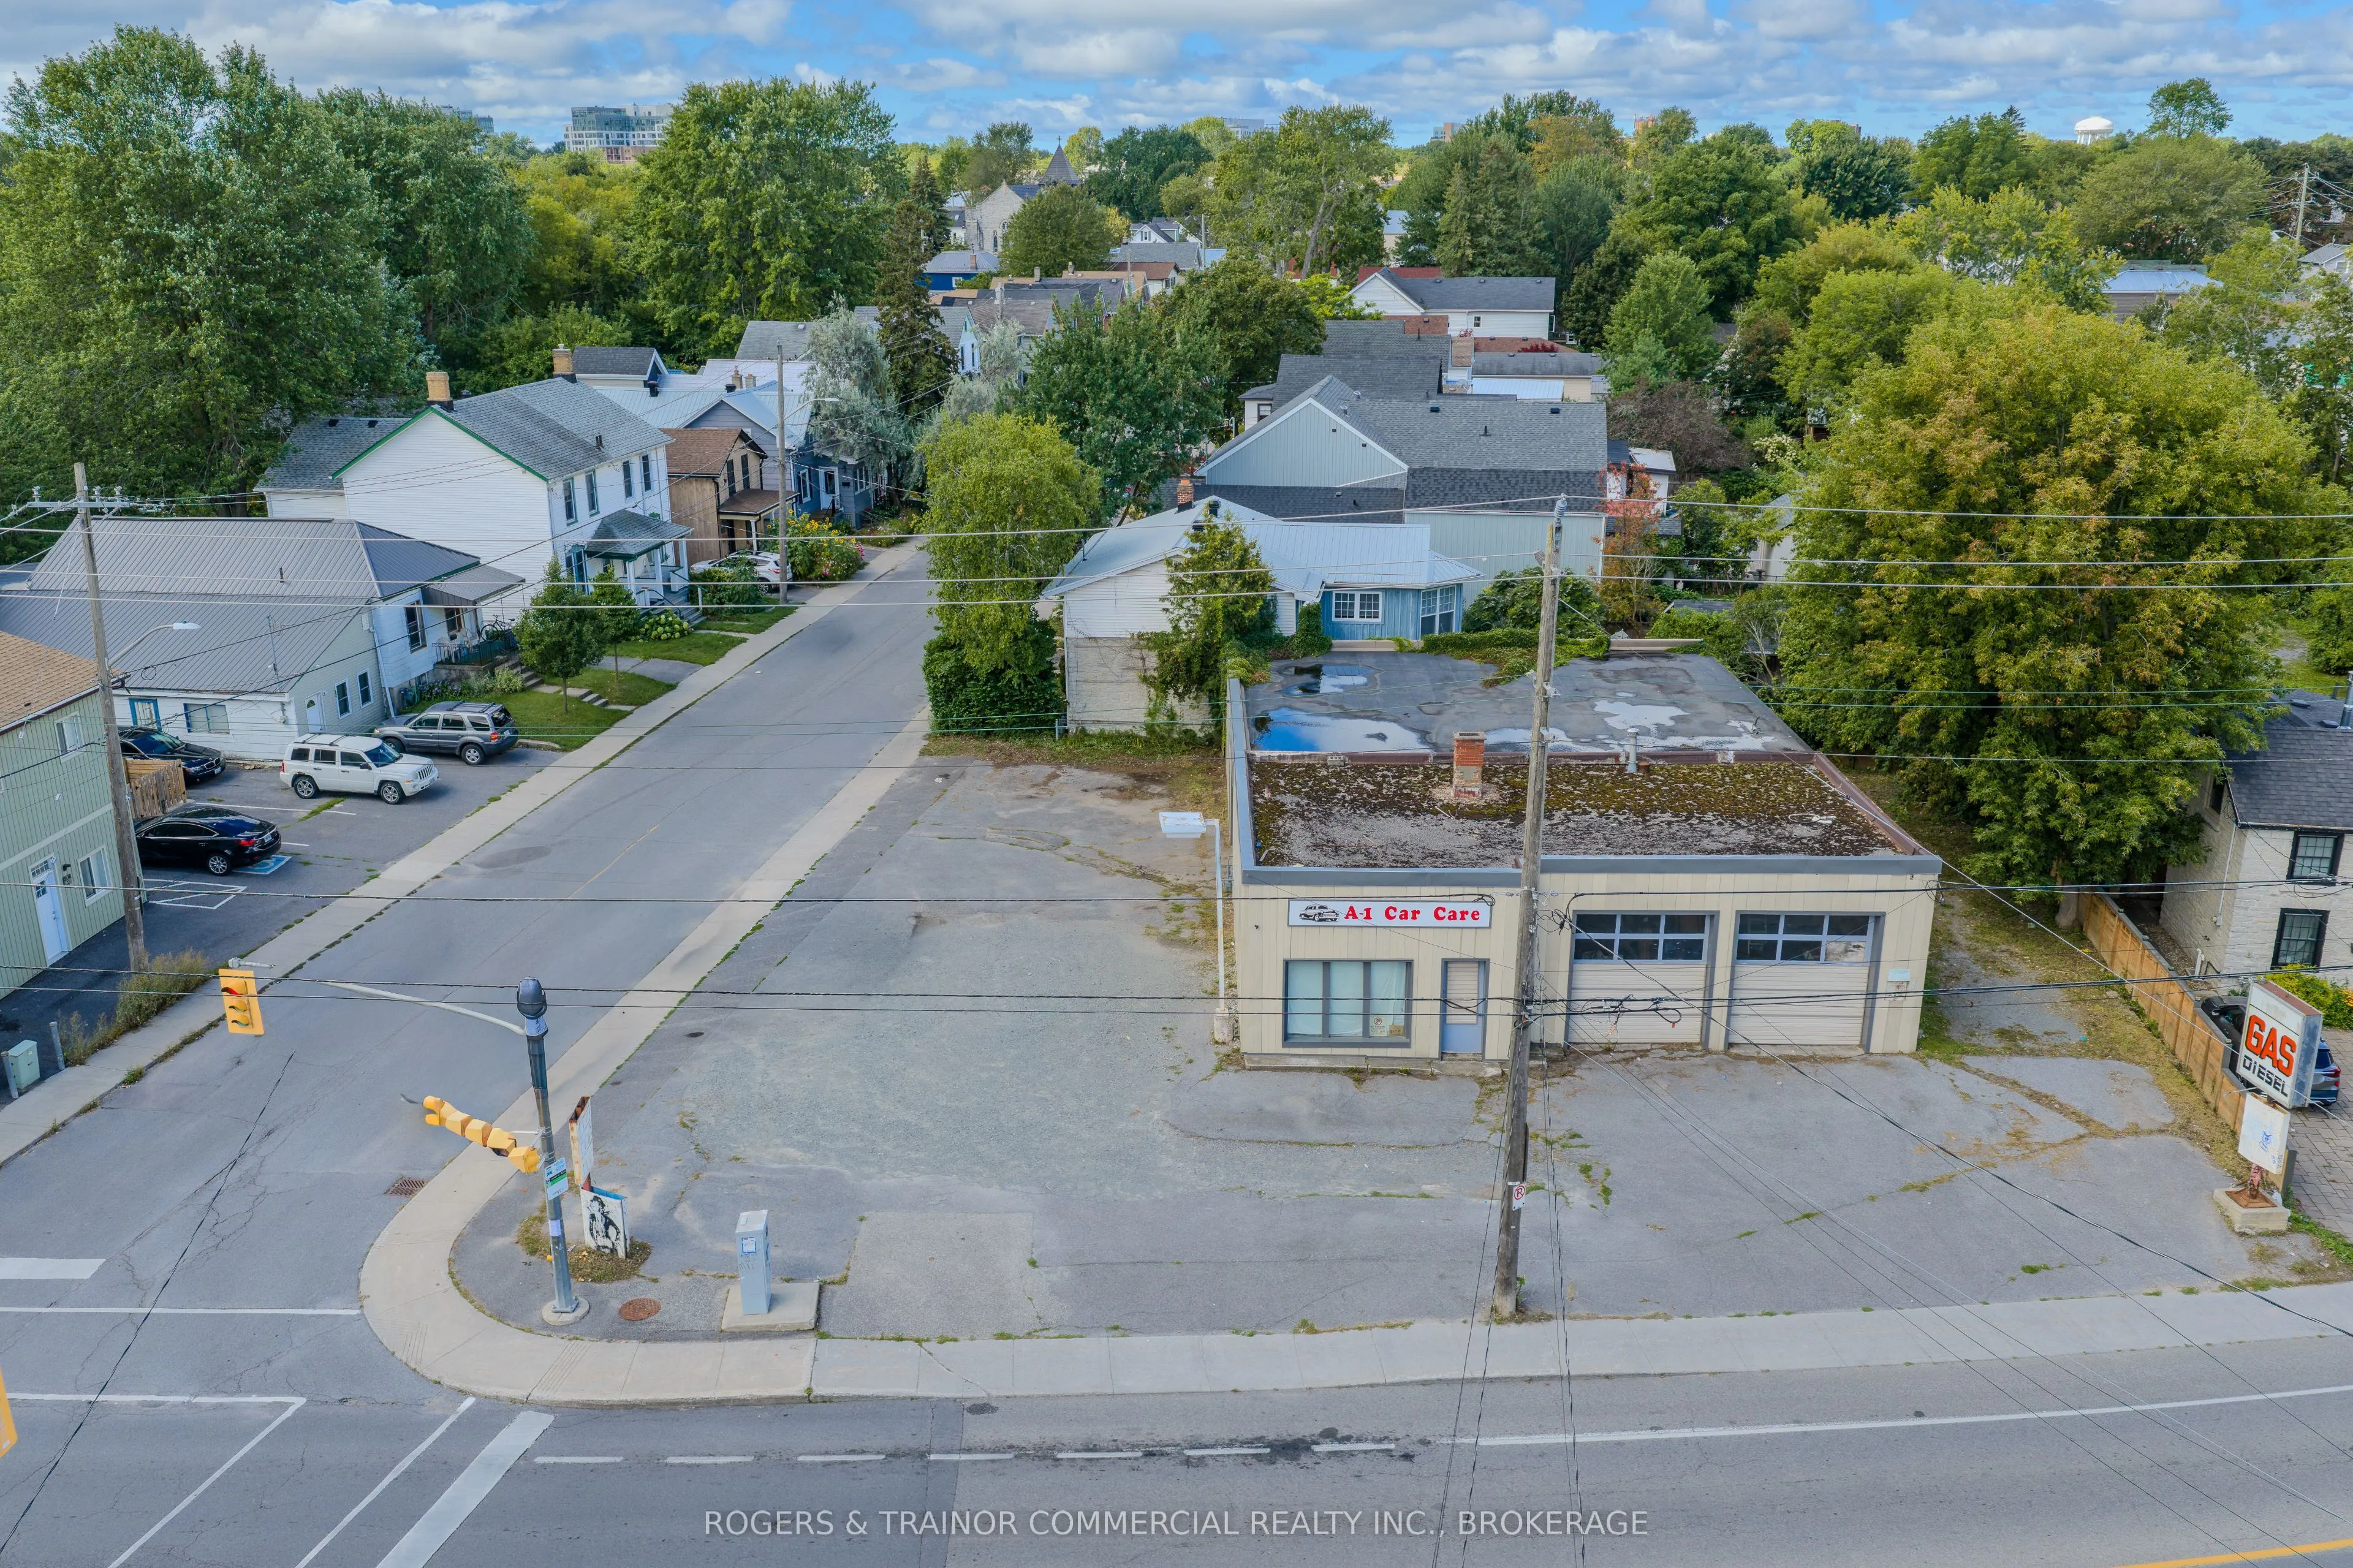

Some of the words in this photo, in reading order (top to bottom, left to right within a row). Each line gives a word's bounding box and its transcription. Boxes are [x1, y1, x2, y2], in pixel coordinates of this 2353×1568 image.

[1344, 905, 1373, 920] A-1
[1384, 906, 1420, 920] Car
[1433, 906, 1480, 921] Care
[2245, 1014, 2297, 1077] GAS
[2243, 1054, 2289, 1098] DIESEL
